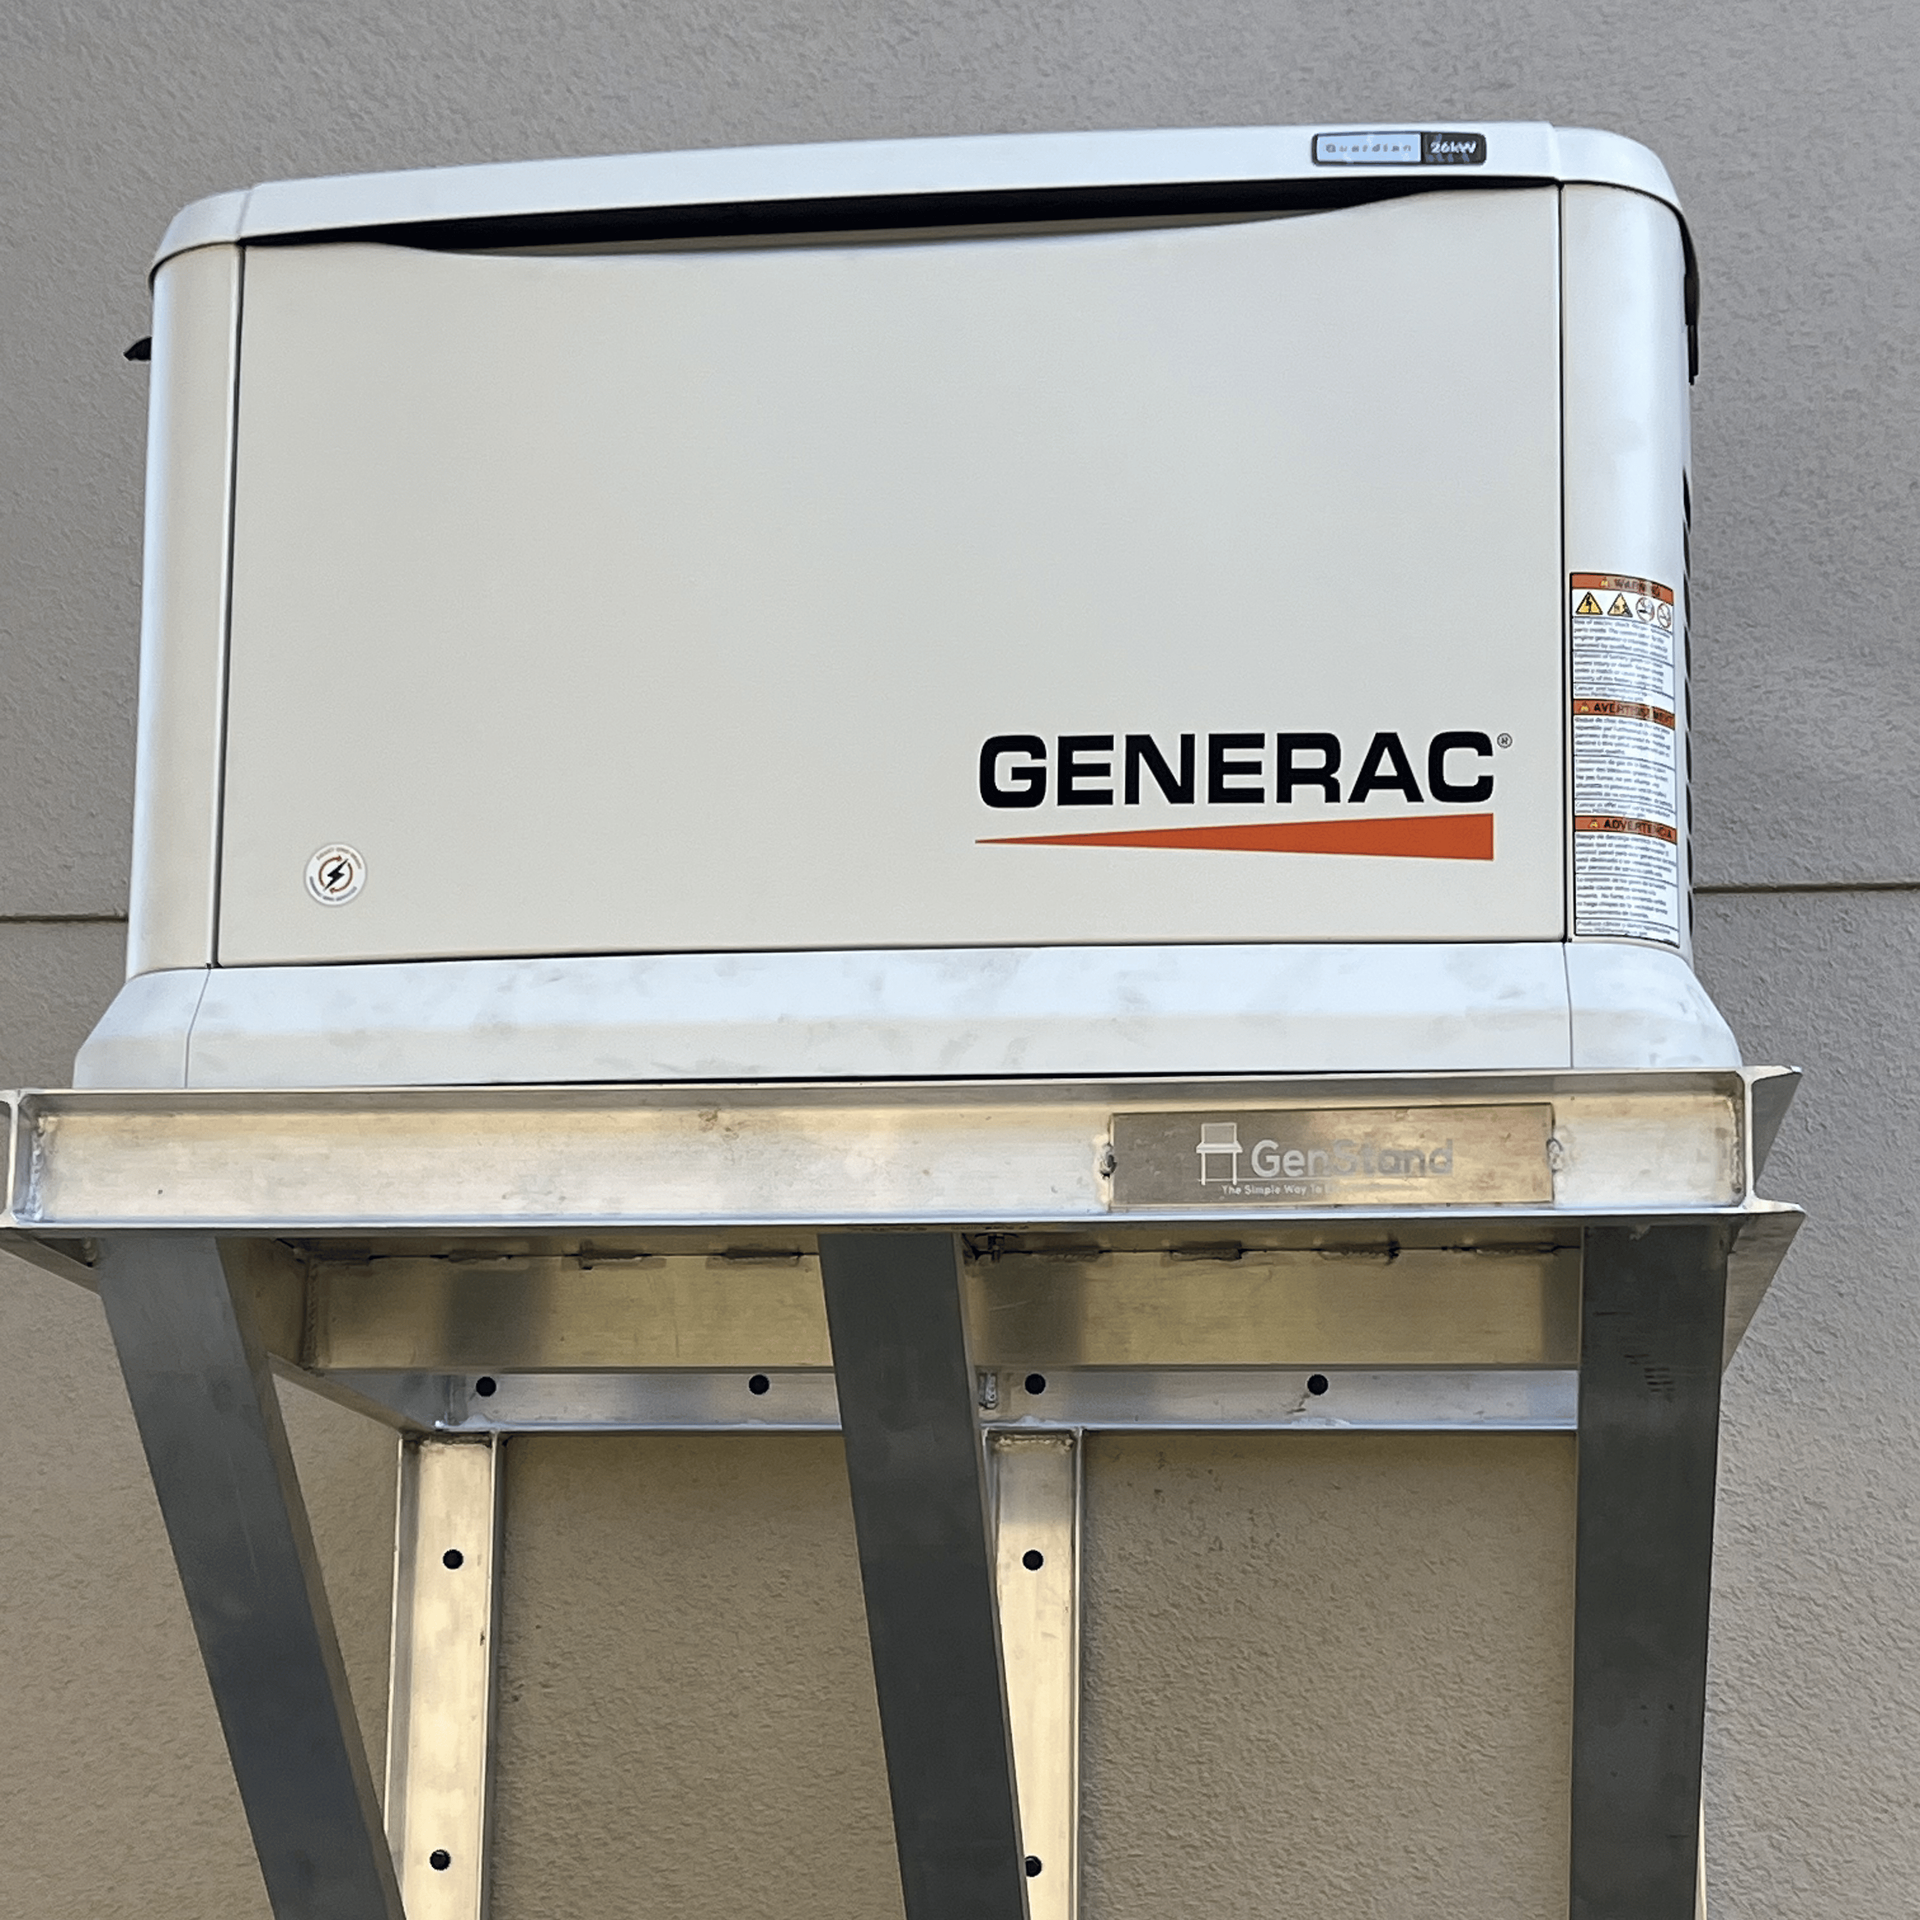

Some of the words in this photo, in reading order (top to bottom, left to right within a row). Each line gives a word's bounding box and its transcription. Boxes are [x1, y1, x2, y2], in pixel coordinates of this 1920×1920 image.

[1325, 143, 1412, 153] Guardian
[979, 730, 1495, 808] GENERAC
[1251, 1138, 1454, 1178] GenStand
[1221, 1184, 1242, 1195] The
[1244, 1184, 1281, 1196] Simple
[1283, 1184, 1307, 1196] Way
